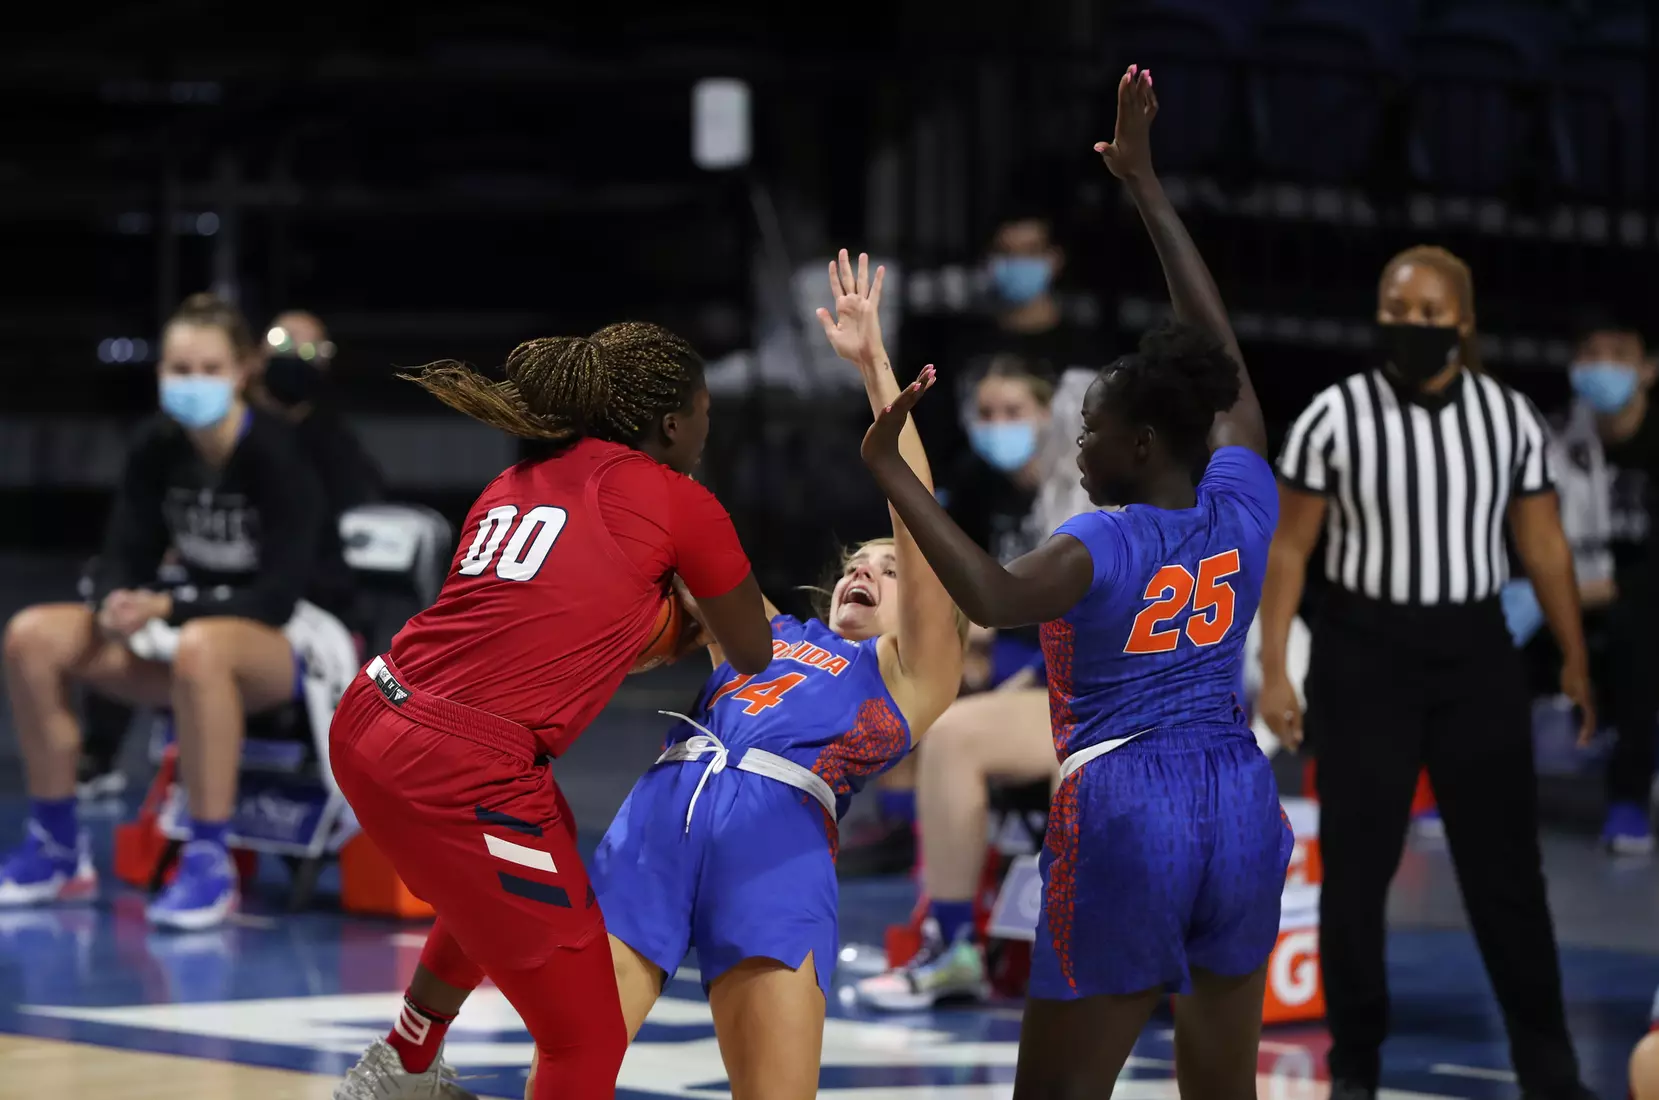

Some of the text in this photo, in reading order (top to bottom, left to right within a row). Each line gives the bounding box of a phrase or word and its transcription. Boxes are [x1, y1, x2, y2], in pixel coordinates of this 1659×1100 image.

[458, 505, 569, 582] 00
[1123, 548, 1240, 654] 25
[707, 672, 808, 716] 14
[772, 639, 850, 677] ORIDA
[1270, 931, 1318, 1006] G
